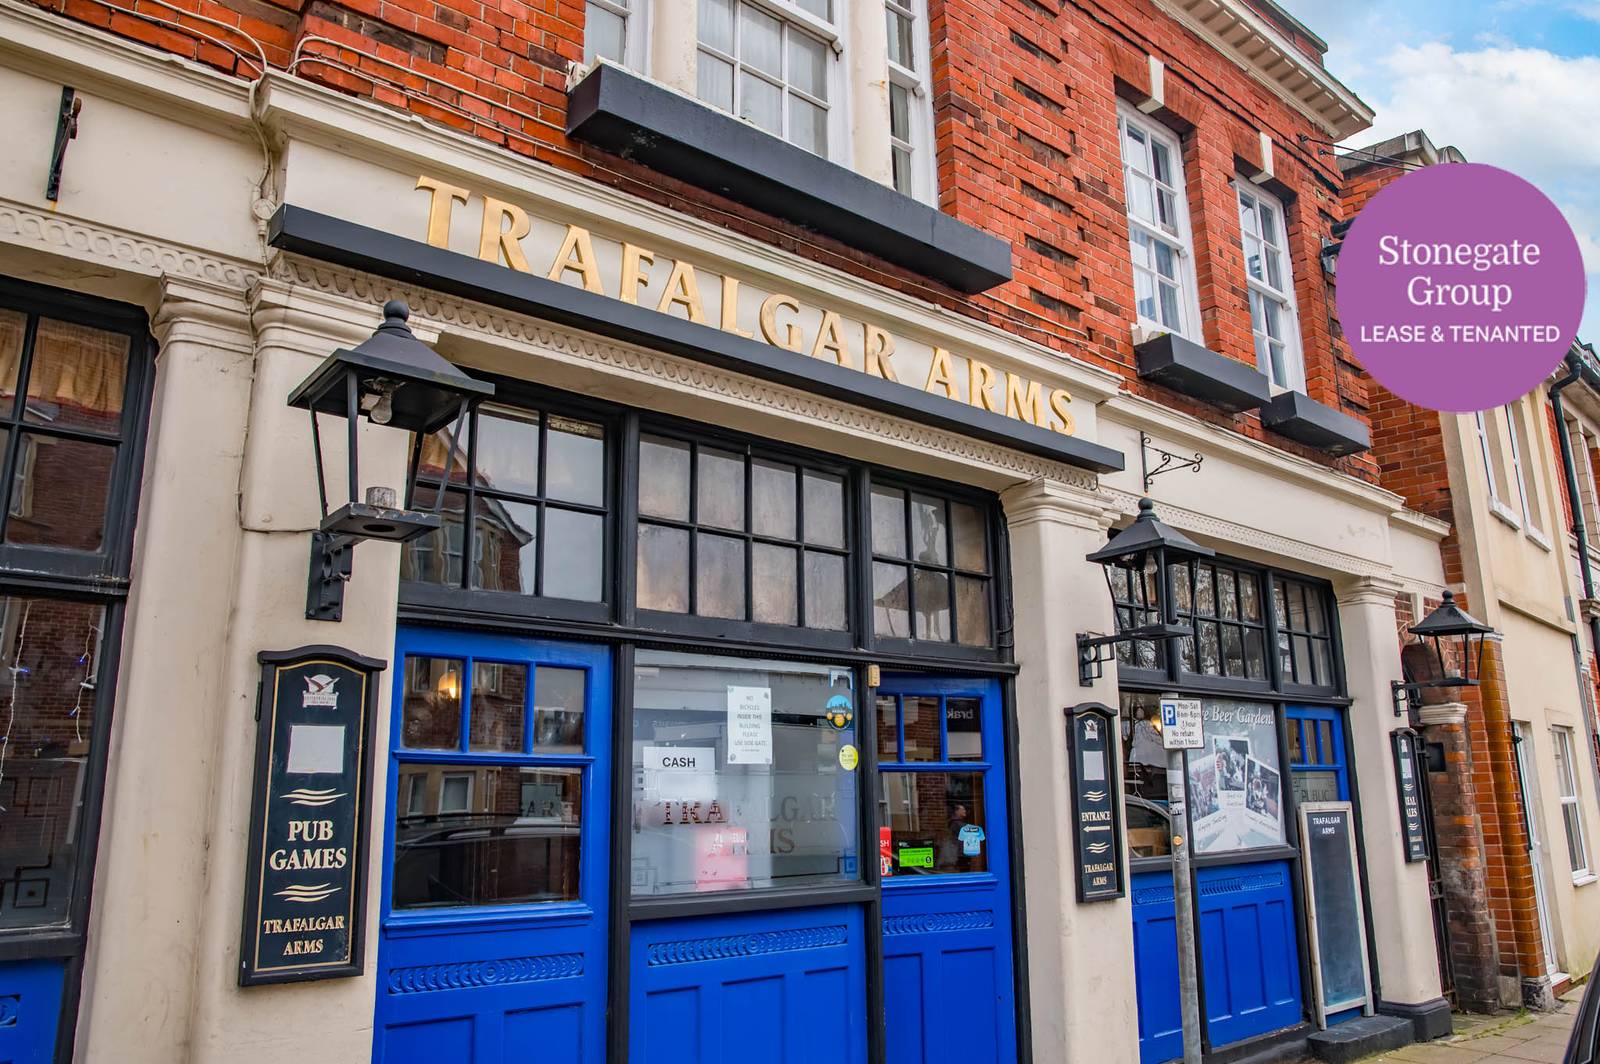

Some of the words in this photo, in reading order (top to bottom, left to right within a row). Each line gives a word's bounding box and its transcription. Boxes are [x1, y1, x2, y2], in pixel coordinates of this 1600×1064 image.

[415, 175, 899, 383] TRAFALGAR
[925, 346, 1075, 437] ARMS
[1212, 705, 1234, 723] Beer
[1236, 706, 1275, 726] Garden!
[662, 757, 696, 768] CASH
[1081, 811, 1111, 822] ENTRANCE
[1313, 816, 1341, 825] TRAFALGAR
[287, 819, 334, 842] PUB
[1322, 827, 1335, 835] ARMS
[269, 847, 347, 871] GAMES
[1085, 863, 1114, 874] TRAFALGAR
[1092, 876, 1108, 886] ARMS
[263, 915, 345, 935] TRAFALGAR
[283, 938, 324, 957] ARMS
